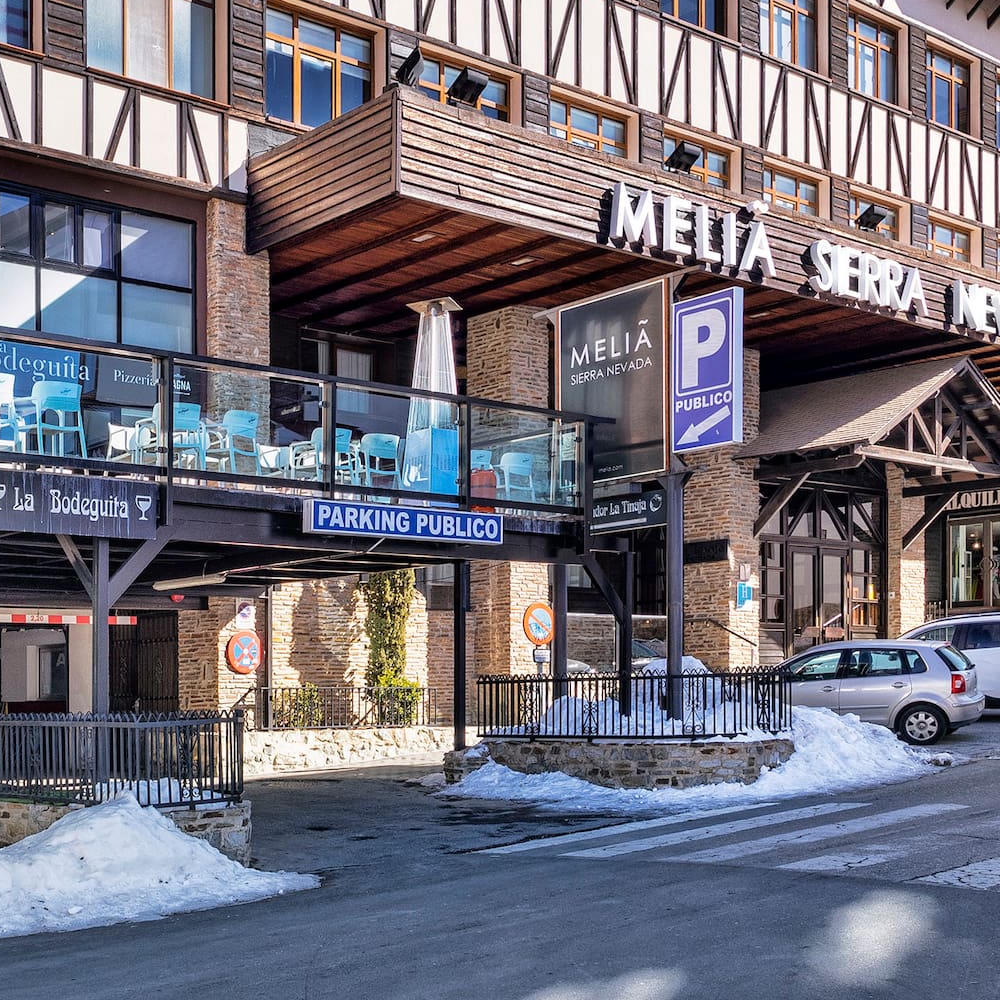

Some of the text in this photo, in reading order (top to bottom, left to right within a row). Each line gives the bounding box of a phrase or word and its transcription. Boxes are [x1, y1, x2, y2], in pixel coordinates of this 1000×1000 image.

[808, 239, 929, 317] SIERRA
[681, 308, 726, 390] P
[570, 356, 653, 386] SIERRA NEVADA
[675, 390, 733, 413] PUBLICO
[12, 486, 129, 522] La Bodeguita
[318, 504, 499, 540] PARKING PUBLICO
[609, 502, 620, 516] La
